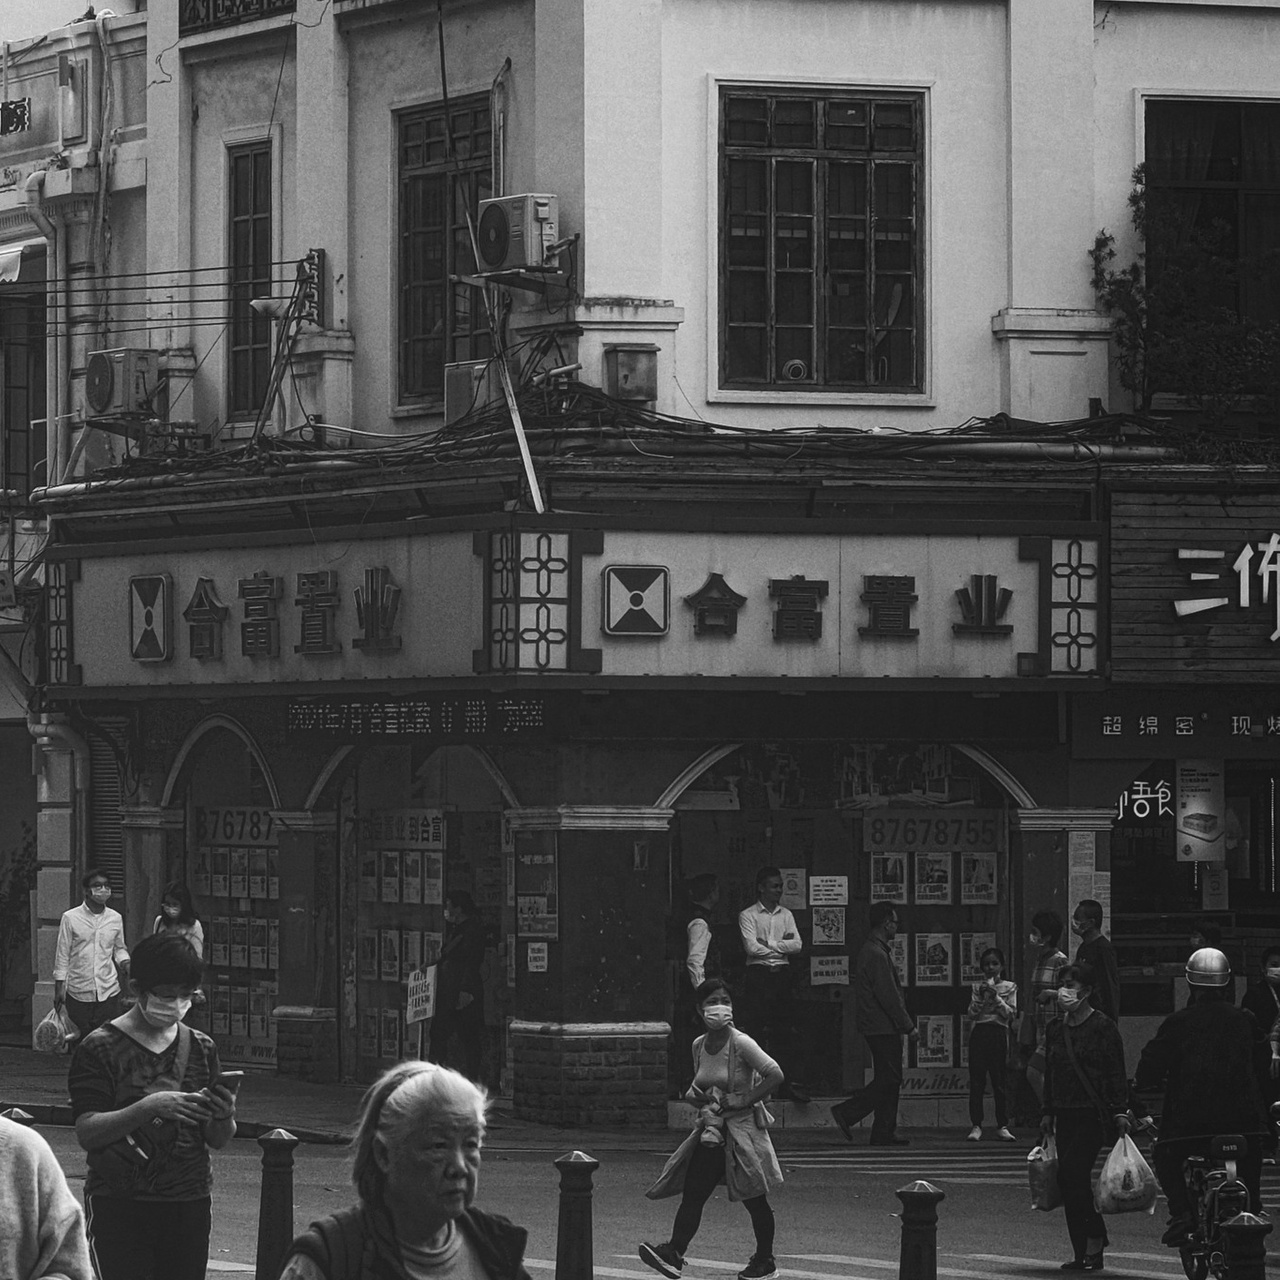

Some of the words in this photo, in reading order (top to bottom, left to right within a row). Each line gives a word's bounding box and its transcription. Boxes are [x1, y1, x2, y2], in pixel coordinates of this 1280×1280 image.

[184, 566, 402, 661] 合富置业
[683, 572, 1014, 641] 合富置业
[1102, 715, 1194, 736] 超绵密
[871, 818, 995, 845] 87678755
